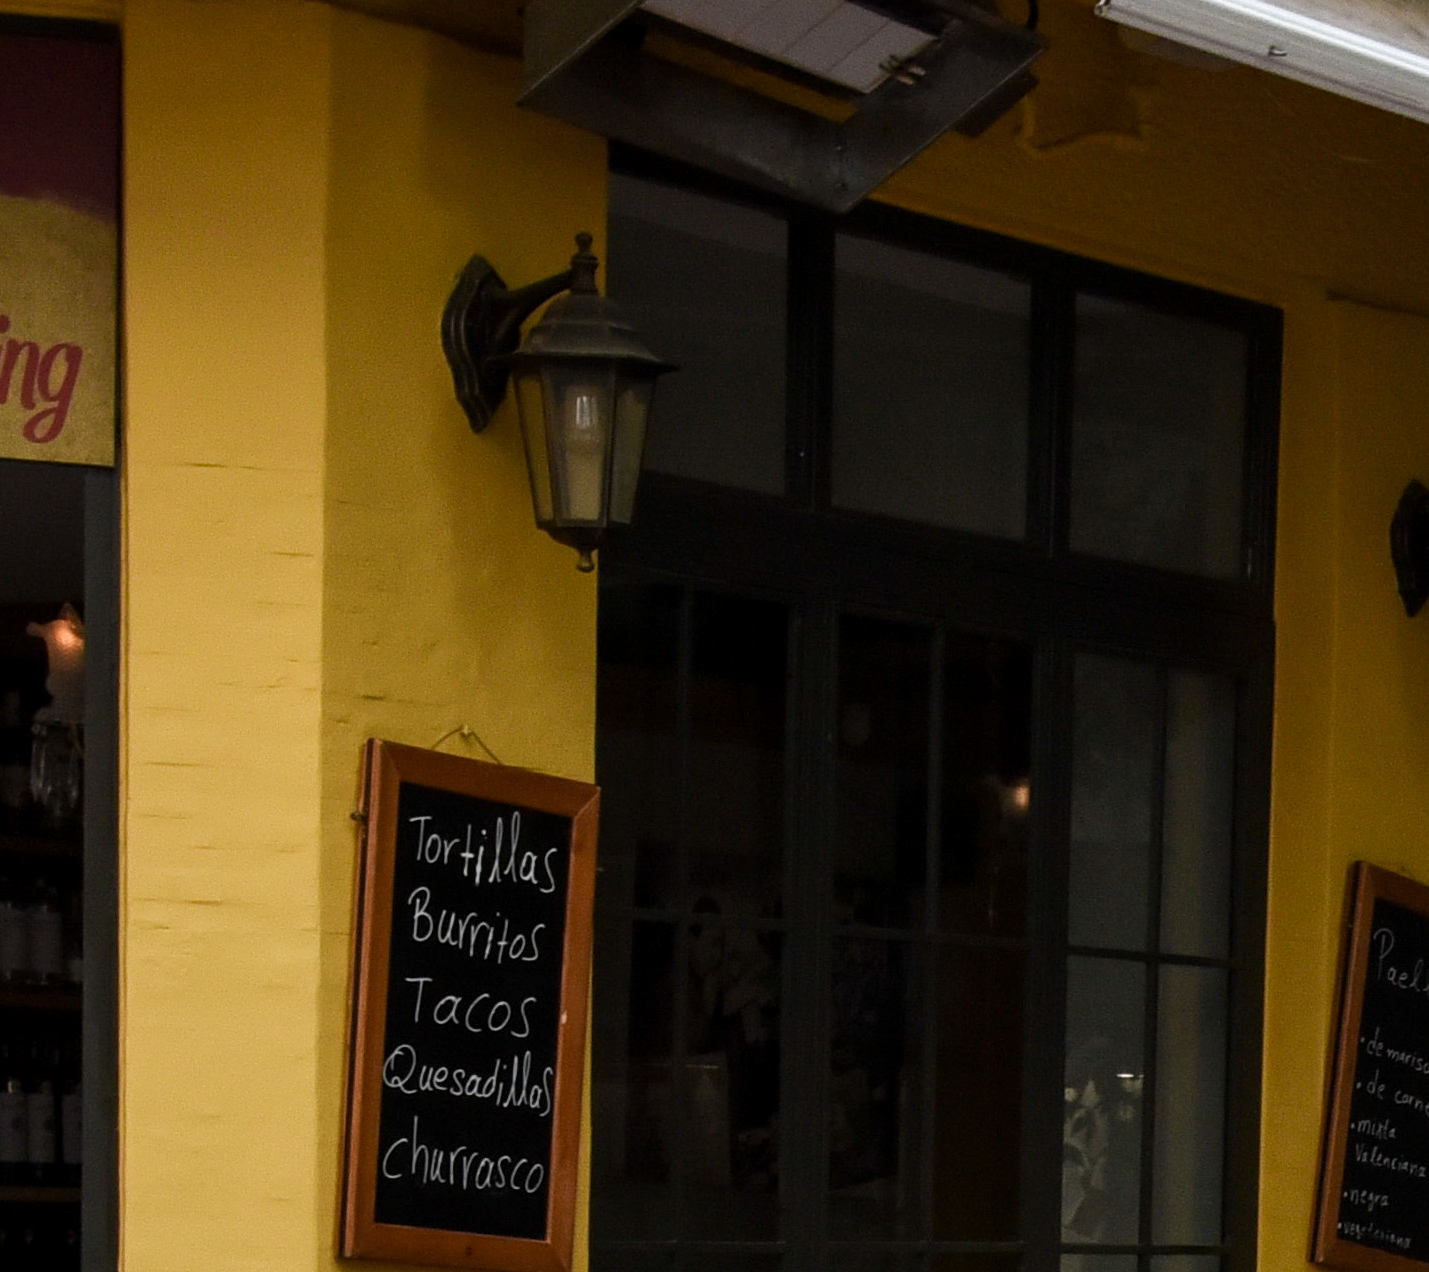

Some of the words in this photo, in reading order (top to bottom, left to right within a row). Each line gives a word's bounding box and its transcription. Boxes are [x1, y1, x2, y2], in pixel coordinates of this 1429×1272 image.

[408, 811, 558, 893] Tortillas
[408, 886, 546, 964] Burritos
[404, 976, 537, 1038] Tacos
[383, 1044, 554, 1116] Quesadillas
